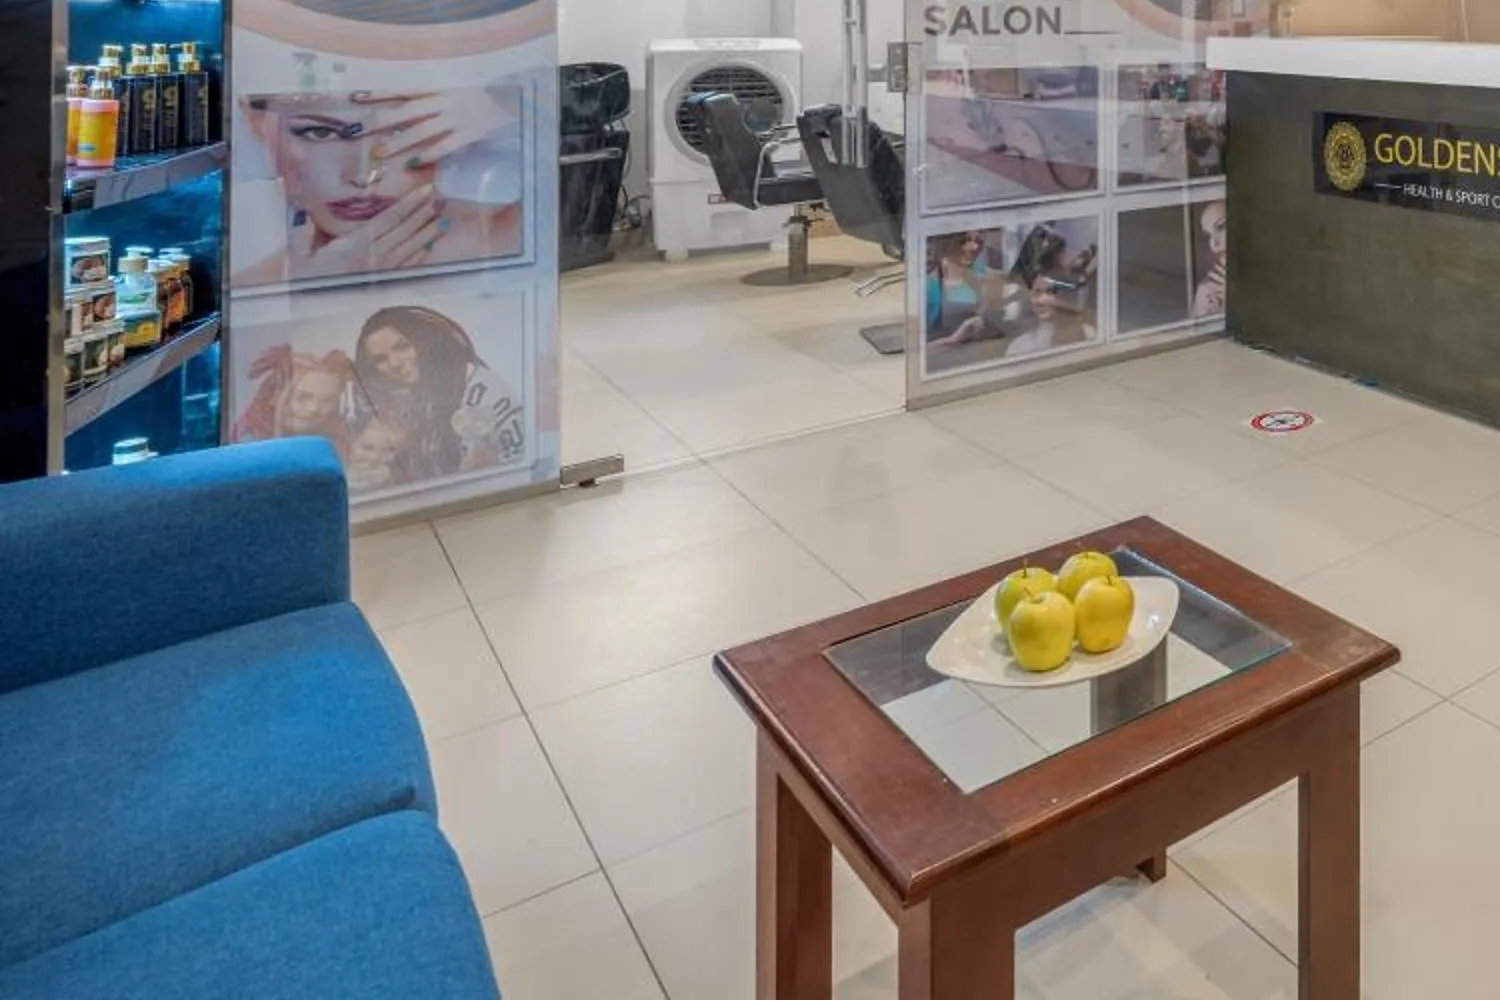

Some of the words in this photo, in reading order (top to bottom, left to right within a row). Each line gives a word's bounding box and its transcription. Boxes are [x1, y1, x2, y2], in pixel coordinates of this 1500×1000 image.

[924, 4, 1062, 37] SALON
[1403, 183, 1443, 200] HEALTH
[1445, 189, 1454, 201] &
[1455, 189, 1490, 207] SPORT
